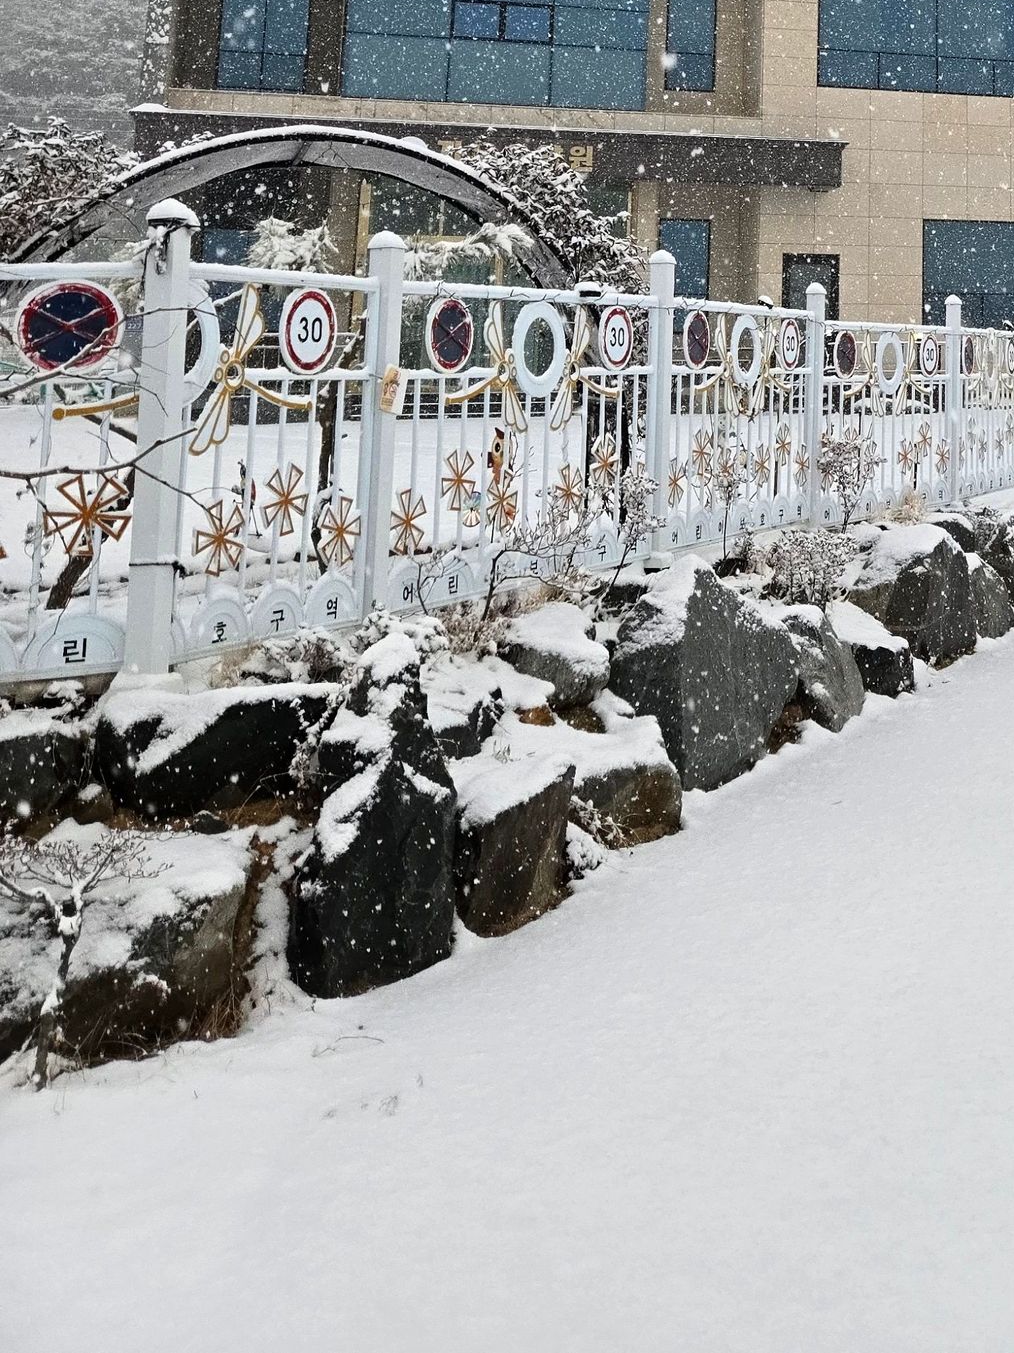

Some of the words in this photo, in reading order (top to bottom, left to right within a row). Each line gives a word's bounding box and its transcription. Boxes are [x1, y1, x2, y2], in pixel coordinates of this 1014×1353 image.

[298, 316, 323, 344] 30
[609, 327, 625, 348] 30
[786, 336, 795, 352] 30
[925, 348, 934, 362] 30
